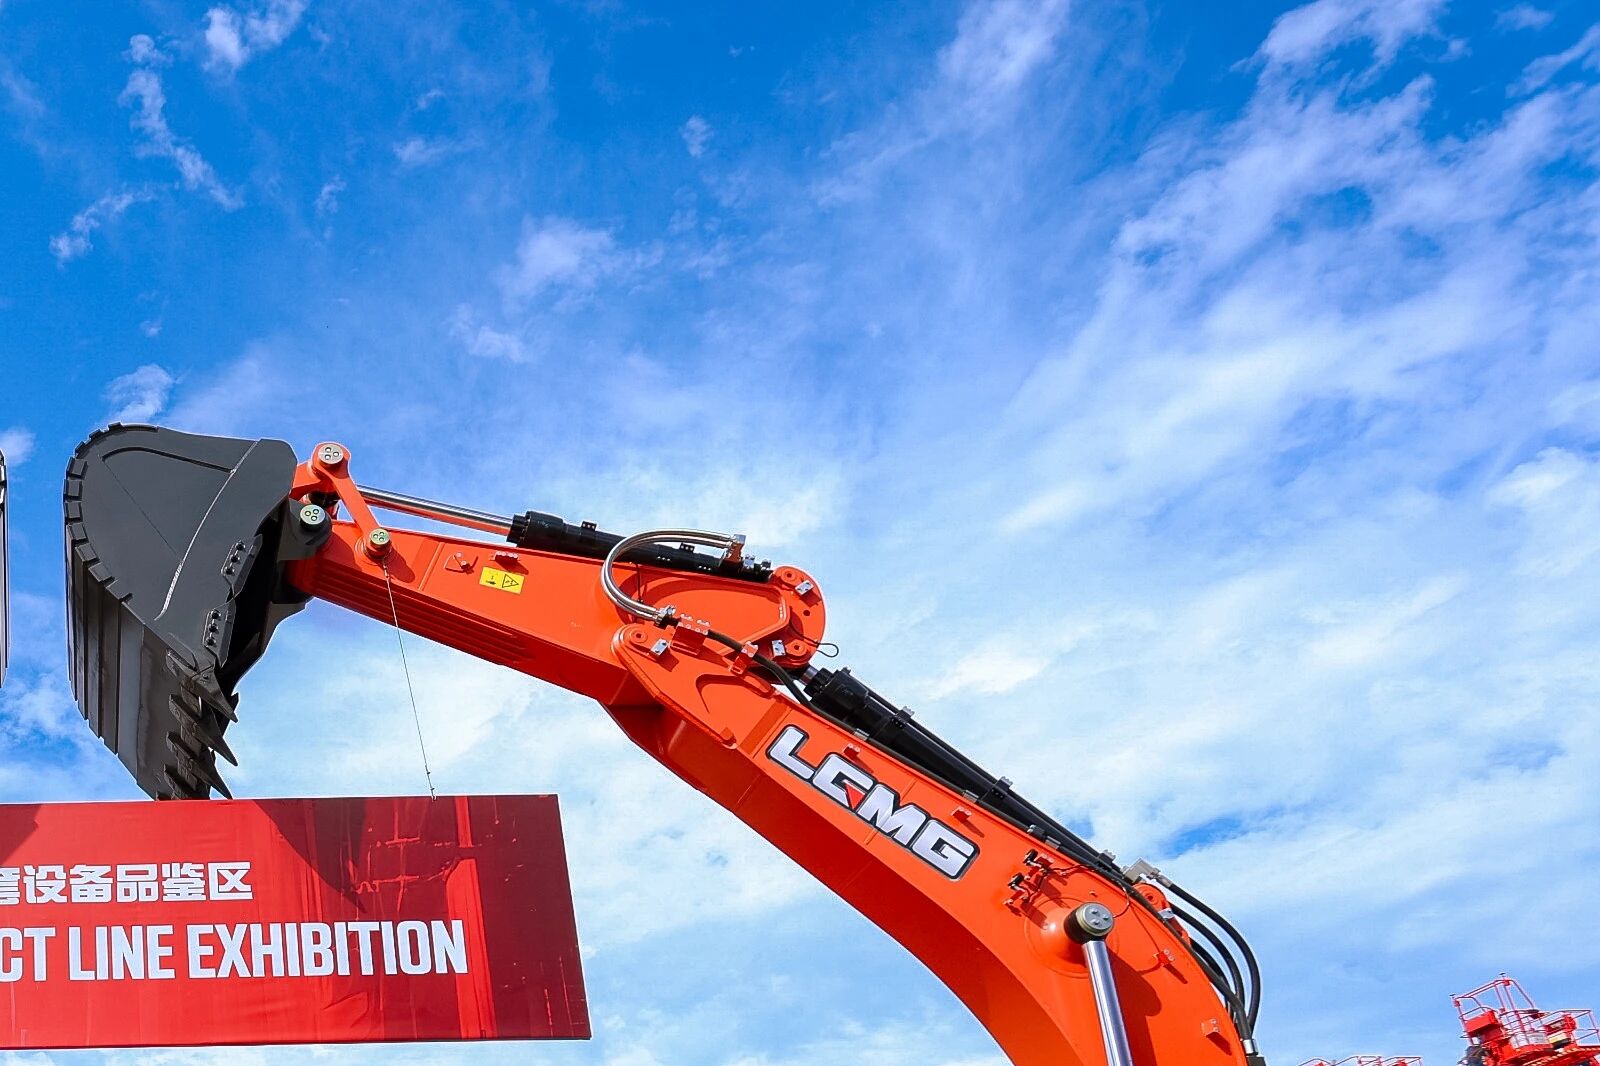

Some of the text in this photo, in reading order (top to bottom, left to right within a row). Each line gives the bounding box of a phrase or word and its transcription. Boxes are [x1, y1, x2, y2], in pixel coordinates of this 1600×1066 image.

[766, 724, 980, 880] LGMG
[68, 924, 176, 981] LINE
[186, 919, 468, 979] EXHIBITION
